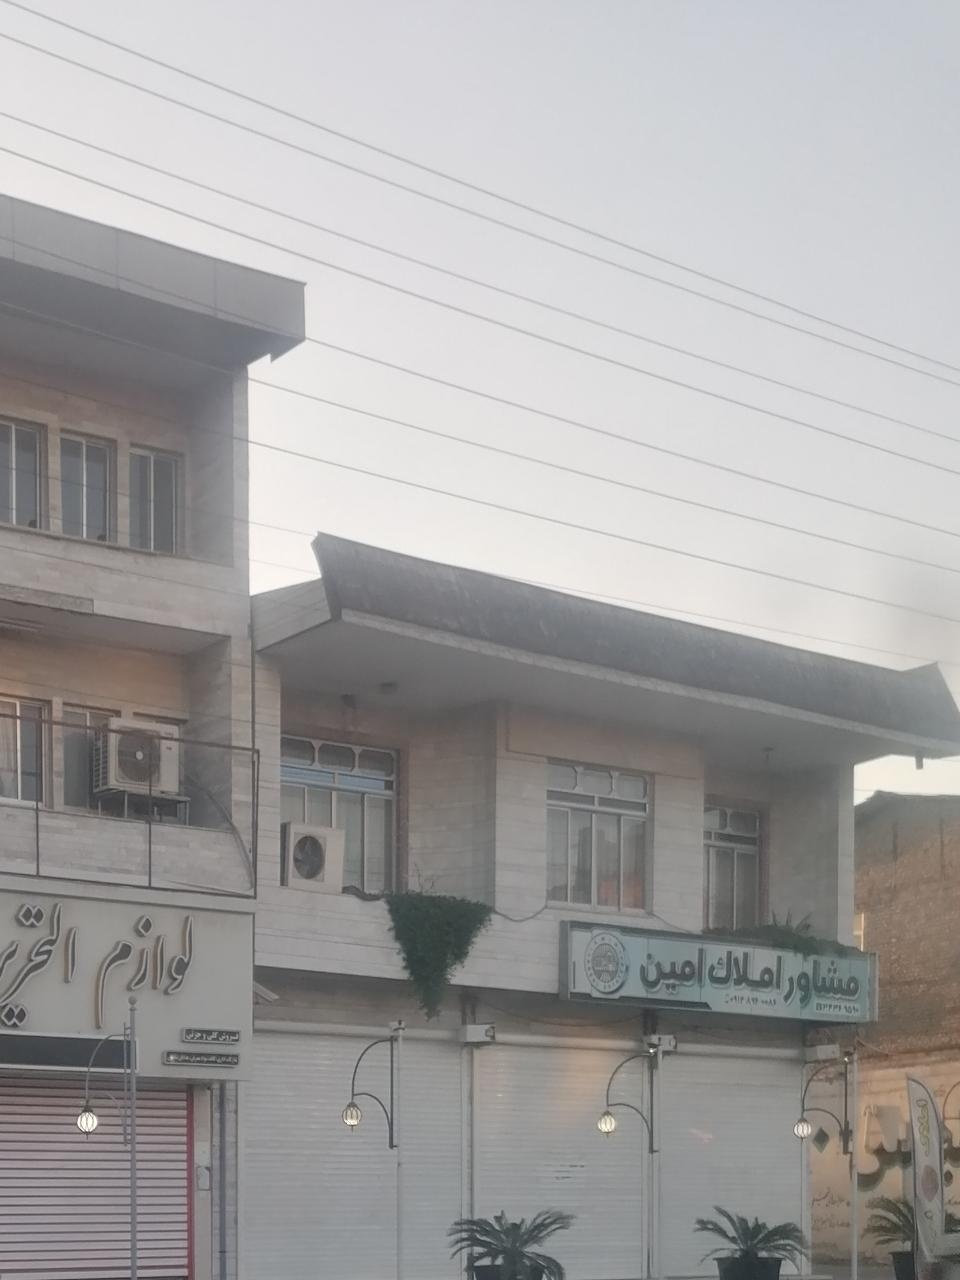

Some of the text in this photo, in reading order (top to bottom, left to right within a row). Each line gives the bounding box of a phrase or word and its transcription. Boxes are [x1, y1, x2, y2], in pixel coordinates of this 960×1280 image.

[94, 914, 194, 1030] لوازم
[639, 947, 704, 993] امین
[782, 958, 861, 1008] مشاور
